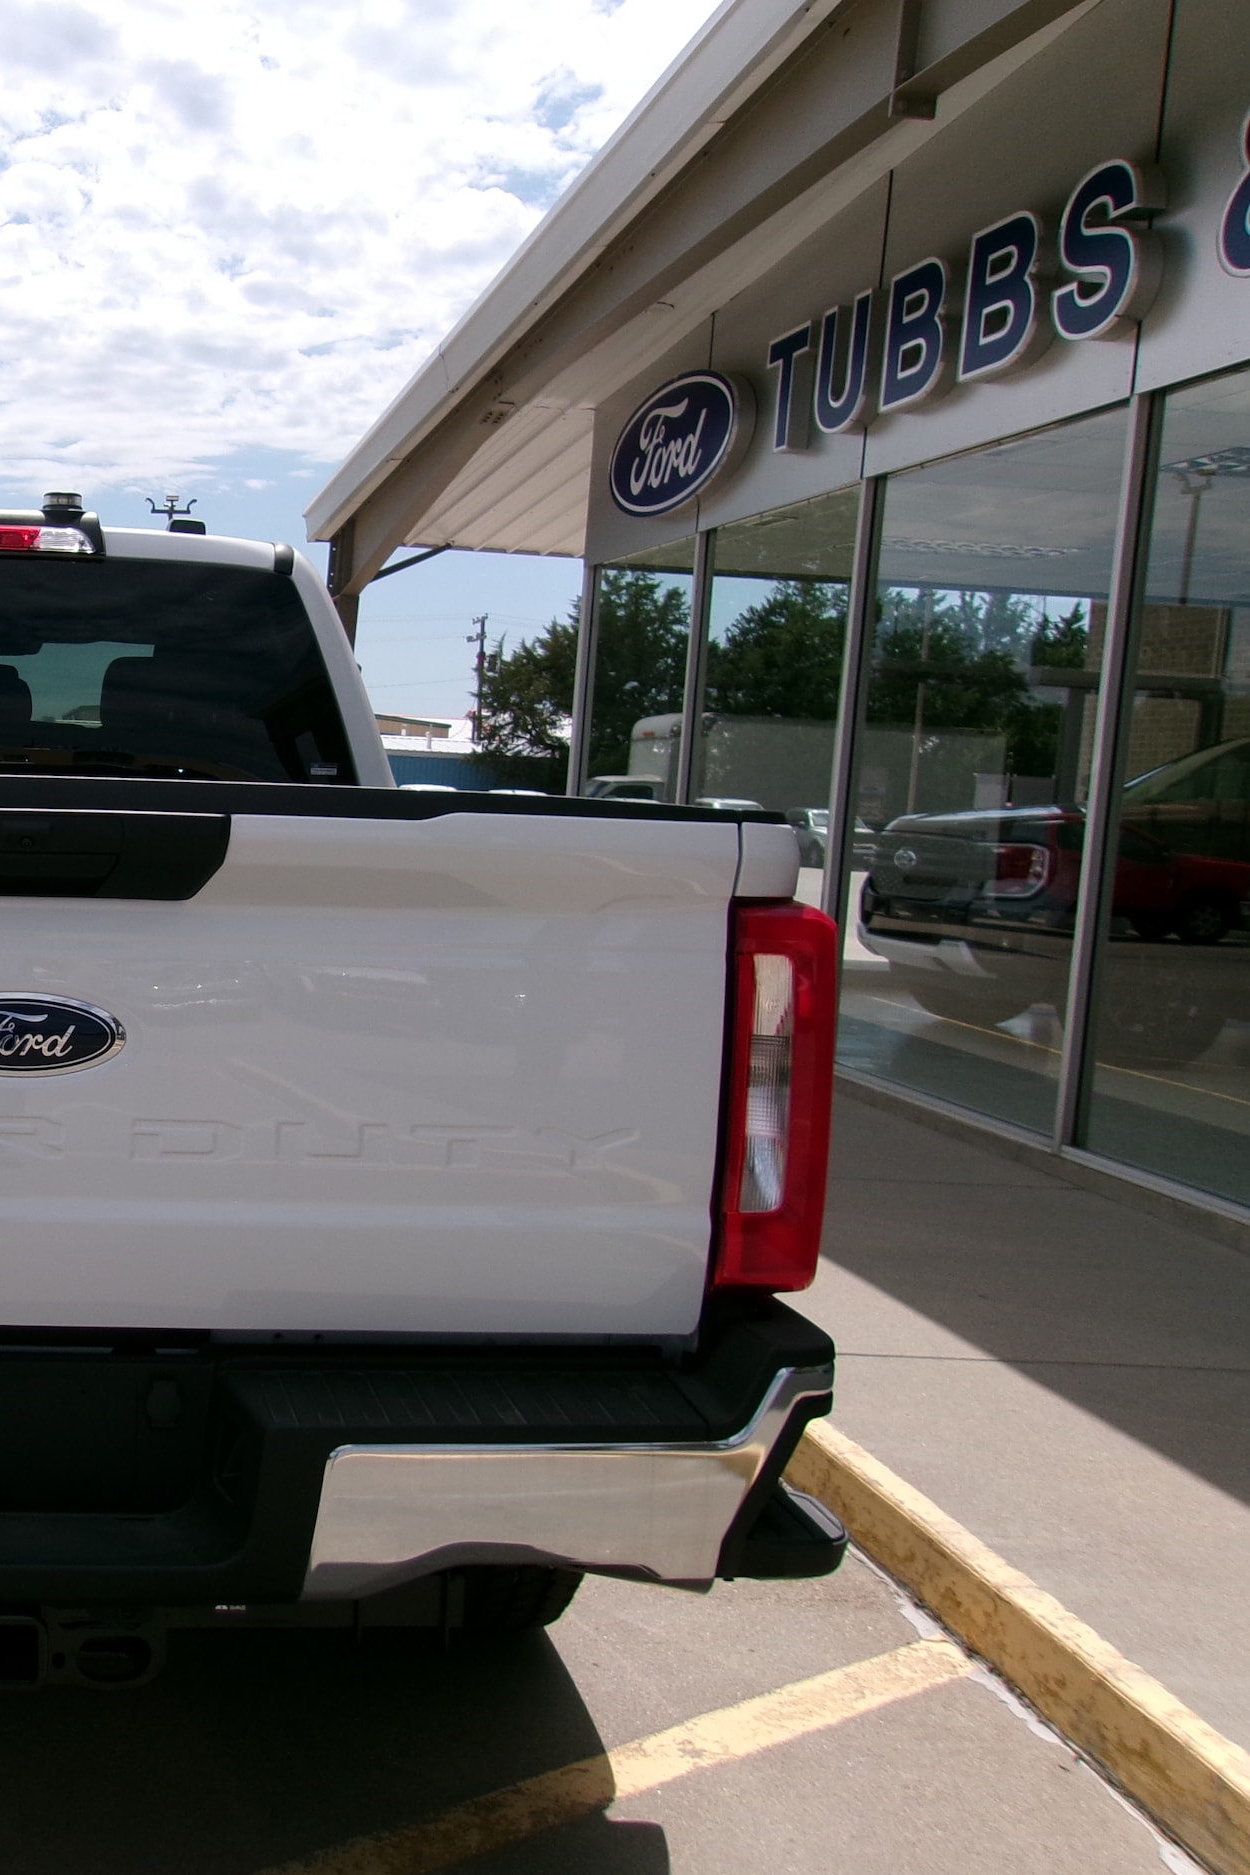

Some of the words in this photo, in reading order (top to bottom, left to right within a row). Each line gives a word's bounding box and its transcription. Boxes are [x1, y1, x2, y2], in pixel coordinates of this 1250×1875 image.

[766, 158, 1138, 453] TUBBS
[629, 397, 708, 496] Ford
[129, 1117, 642, 1170] DUTY
